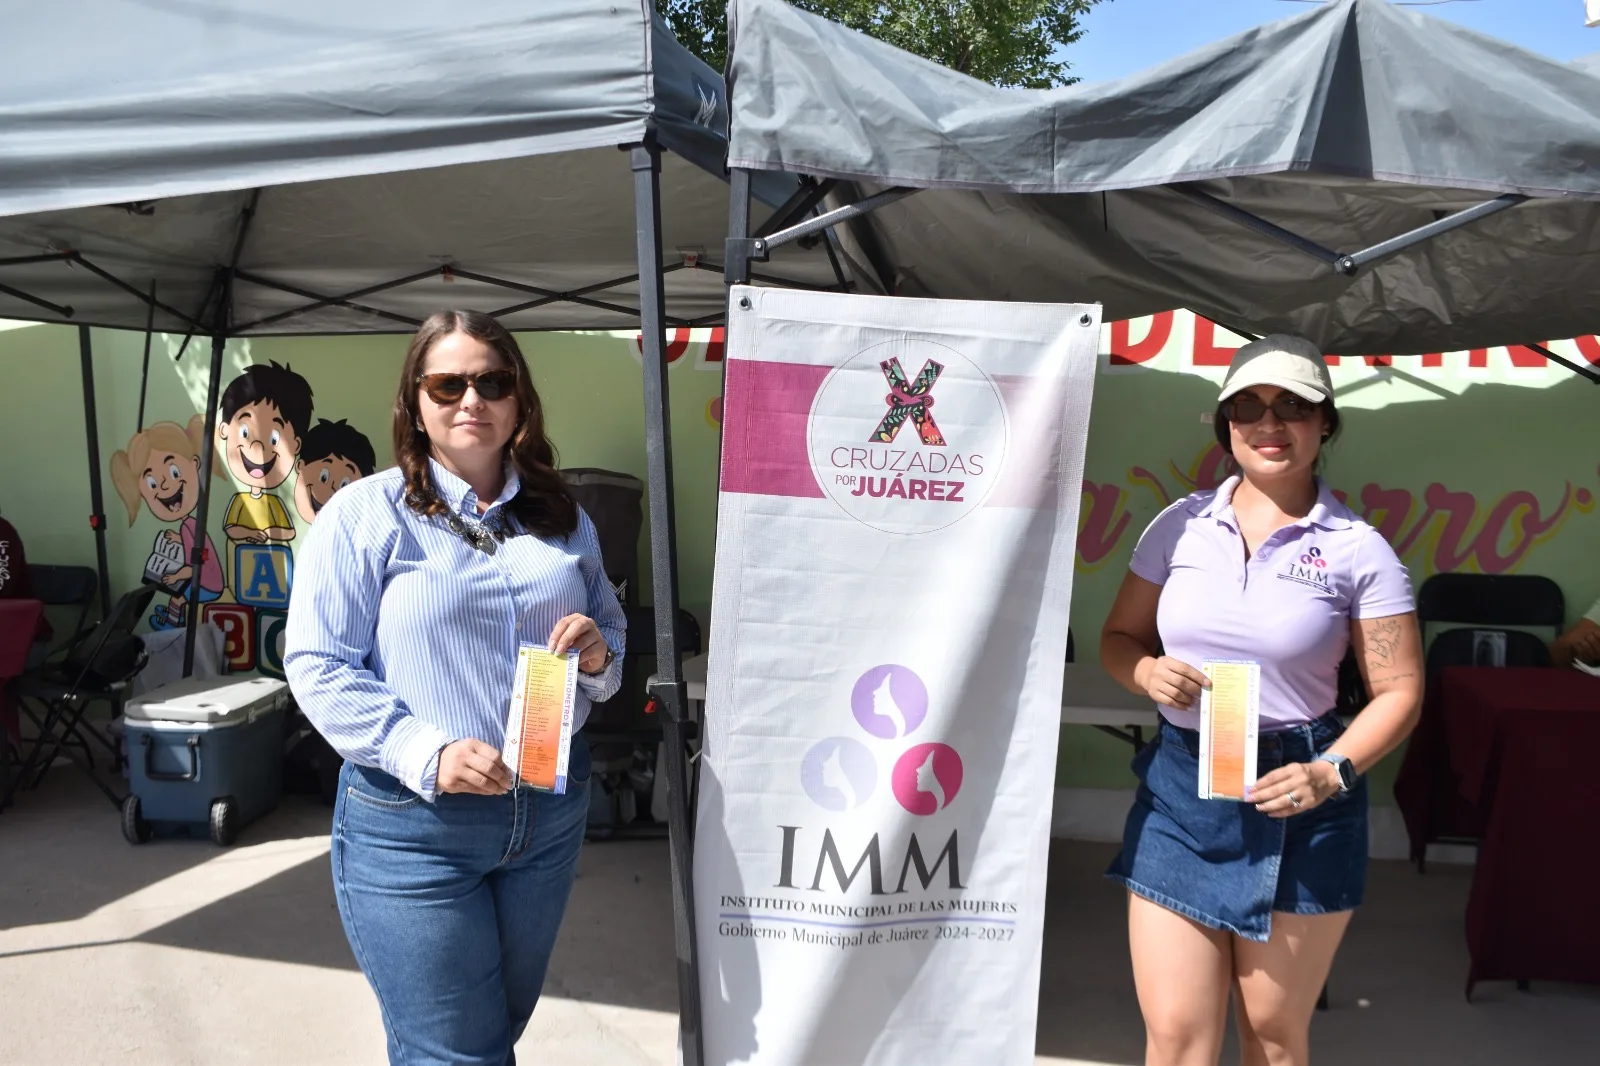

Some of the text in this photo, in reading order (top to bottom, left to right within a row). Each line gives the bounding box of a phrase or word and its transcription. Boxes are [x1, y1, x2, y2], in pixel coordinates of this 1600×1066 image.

[831, 447, 984, 476] CRUZADAS
[835, 473, 965, 502] POR JUÁREZ
[245, 552, 285, 597] A
[1288, 562, 1329, 586] IMM
[213, 613, 245, 659] B
[773, 824, 968, 895] IMM
[720, 895, 1018, 918] INSTITUTO MUNICIPAL DE LAS MUJERES
[719, 921, 1014, 950] Gobierno Municipal de Juárez 2024-2027
